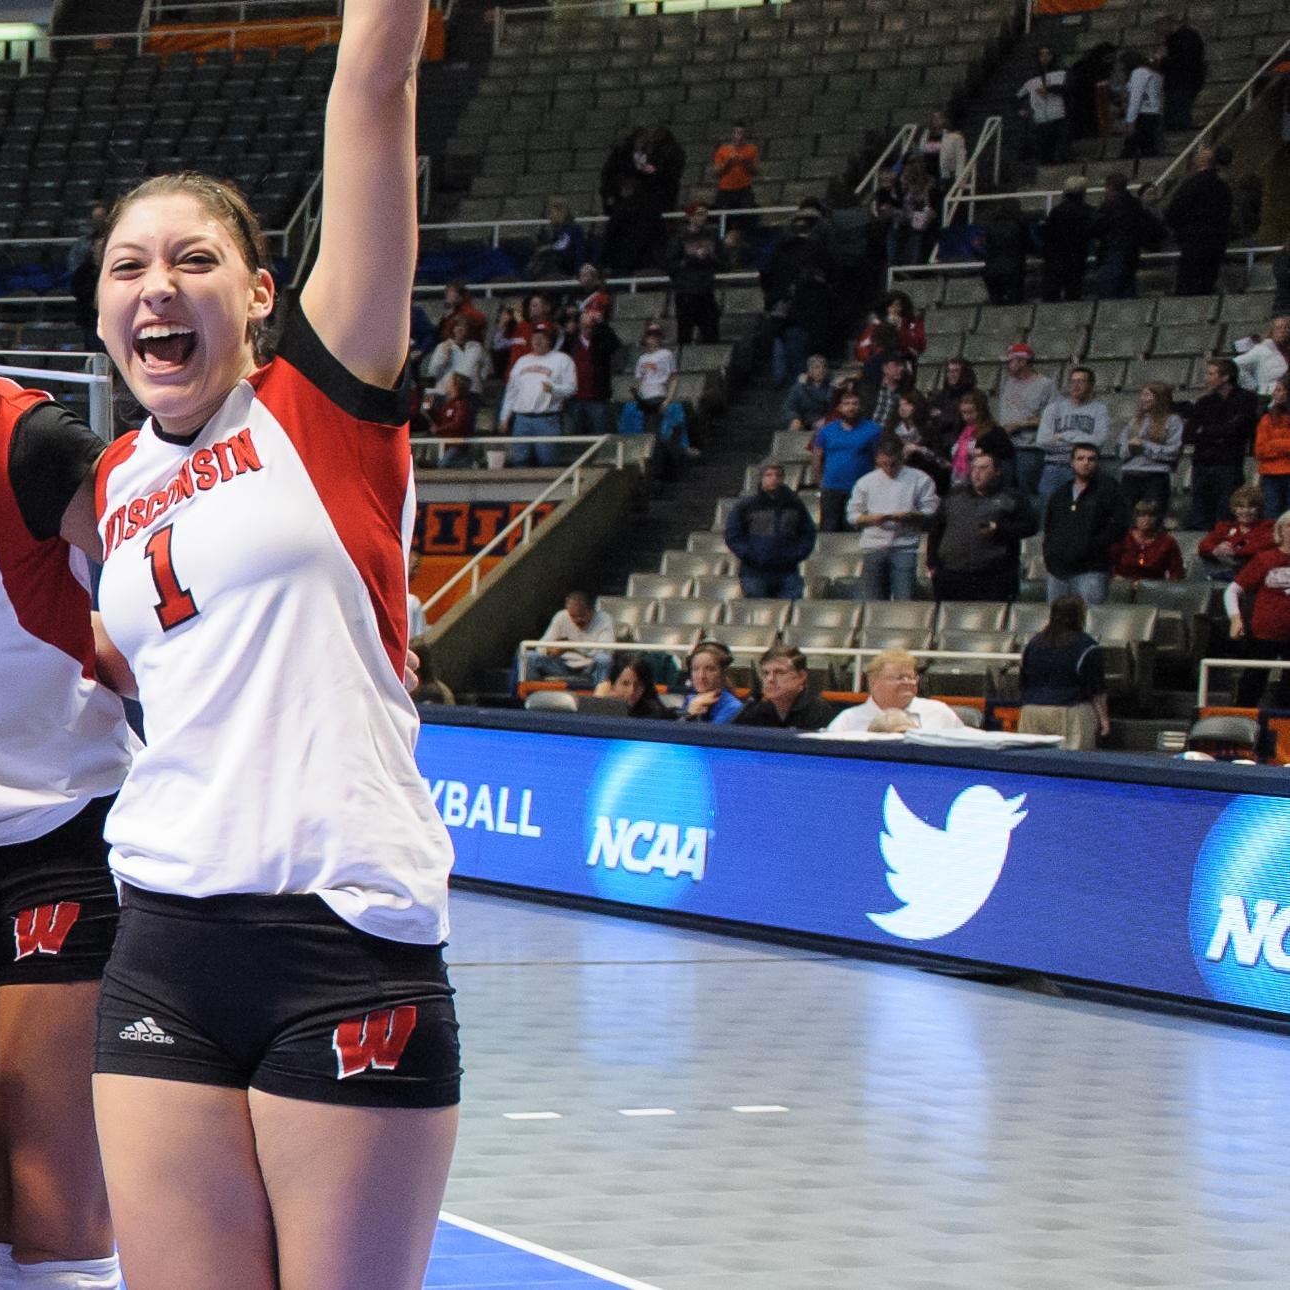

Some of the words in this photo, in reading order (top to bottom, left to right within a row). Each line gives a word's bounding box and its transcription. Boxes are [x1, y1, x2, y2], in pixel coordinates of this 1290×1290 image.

[144, 522, 201, 632] 1
[586, 815, 708, 881] NCAA
[119, 1030, 175, 1045] adidas
